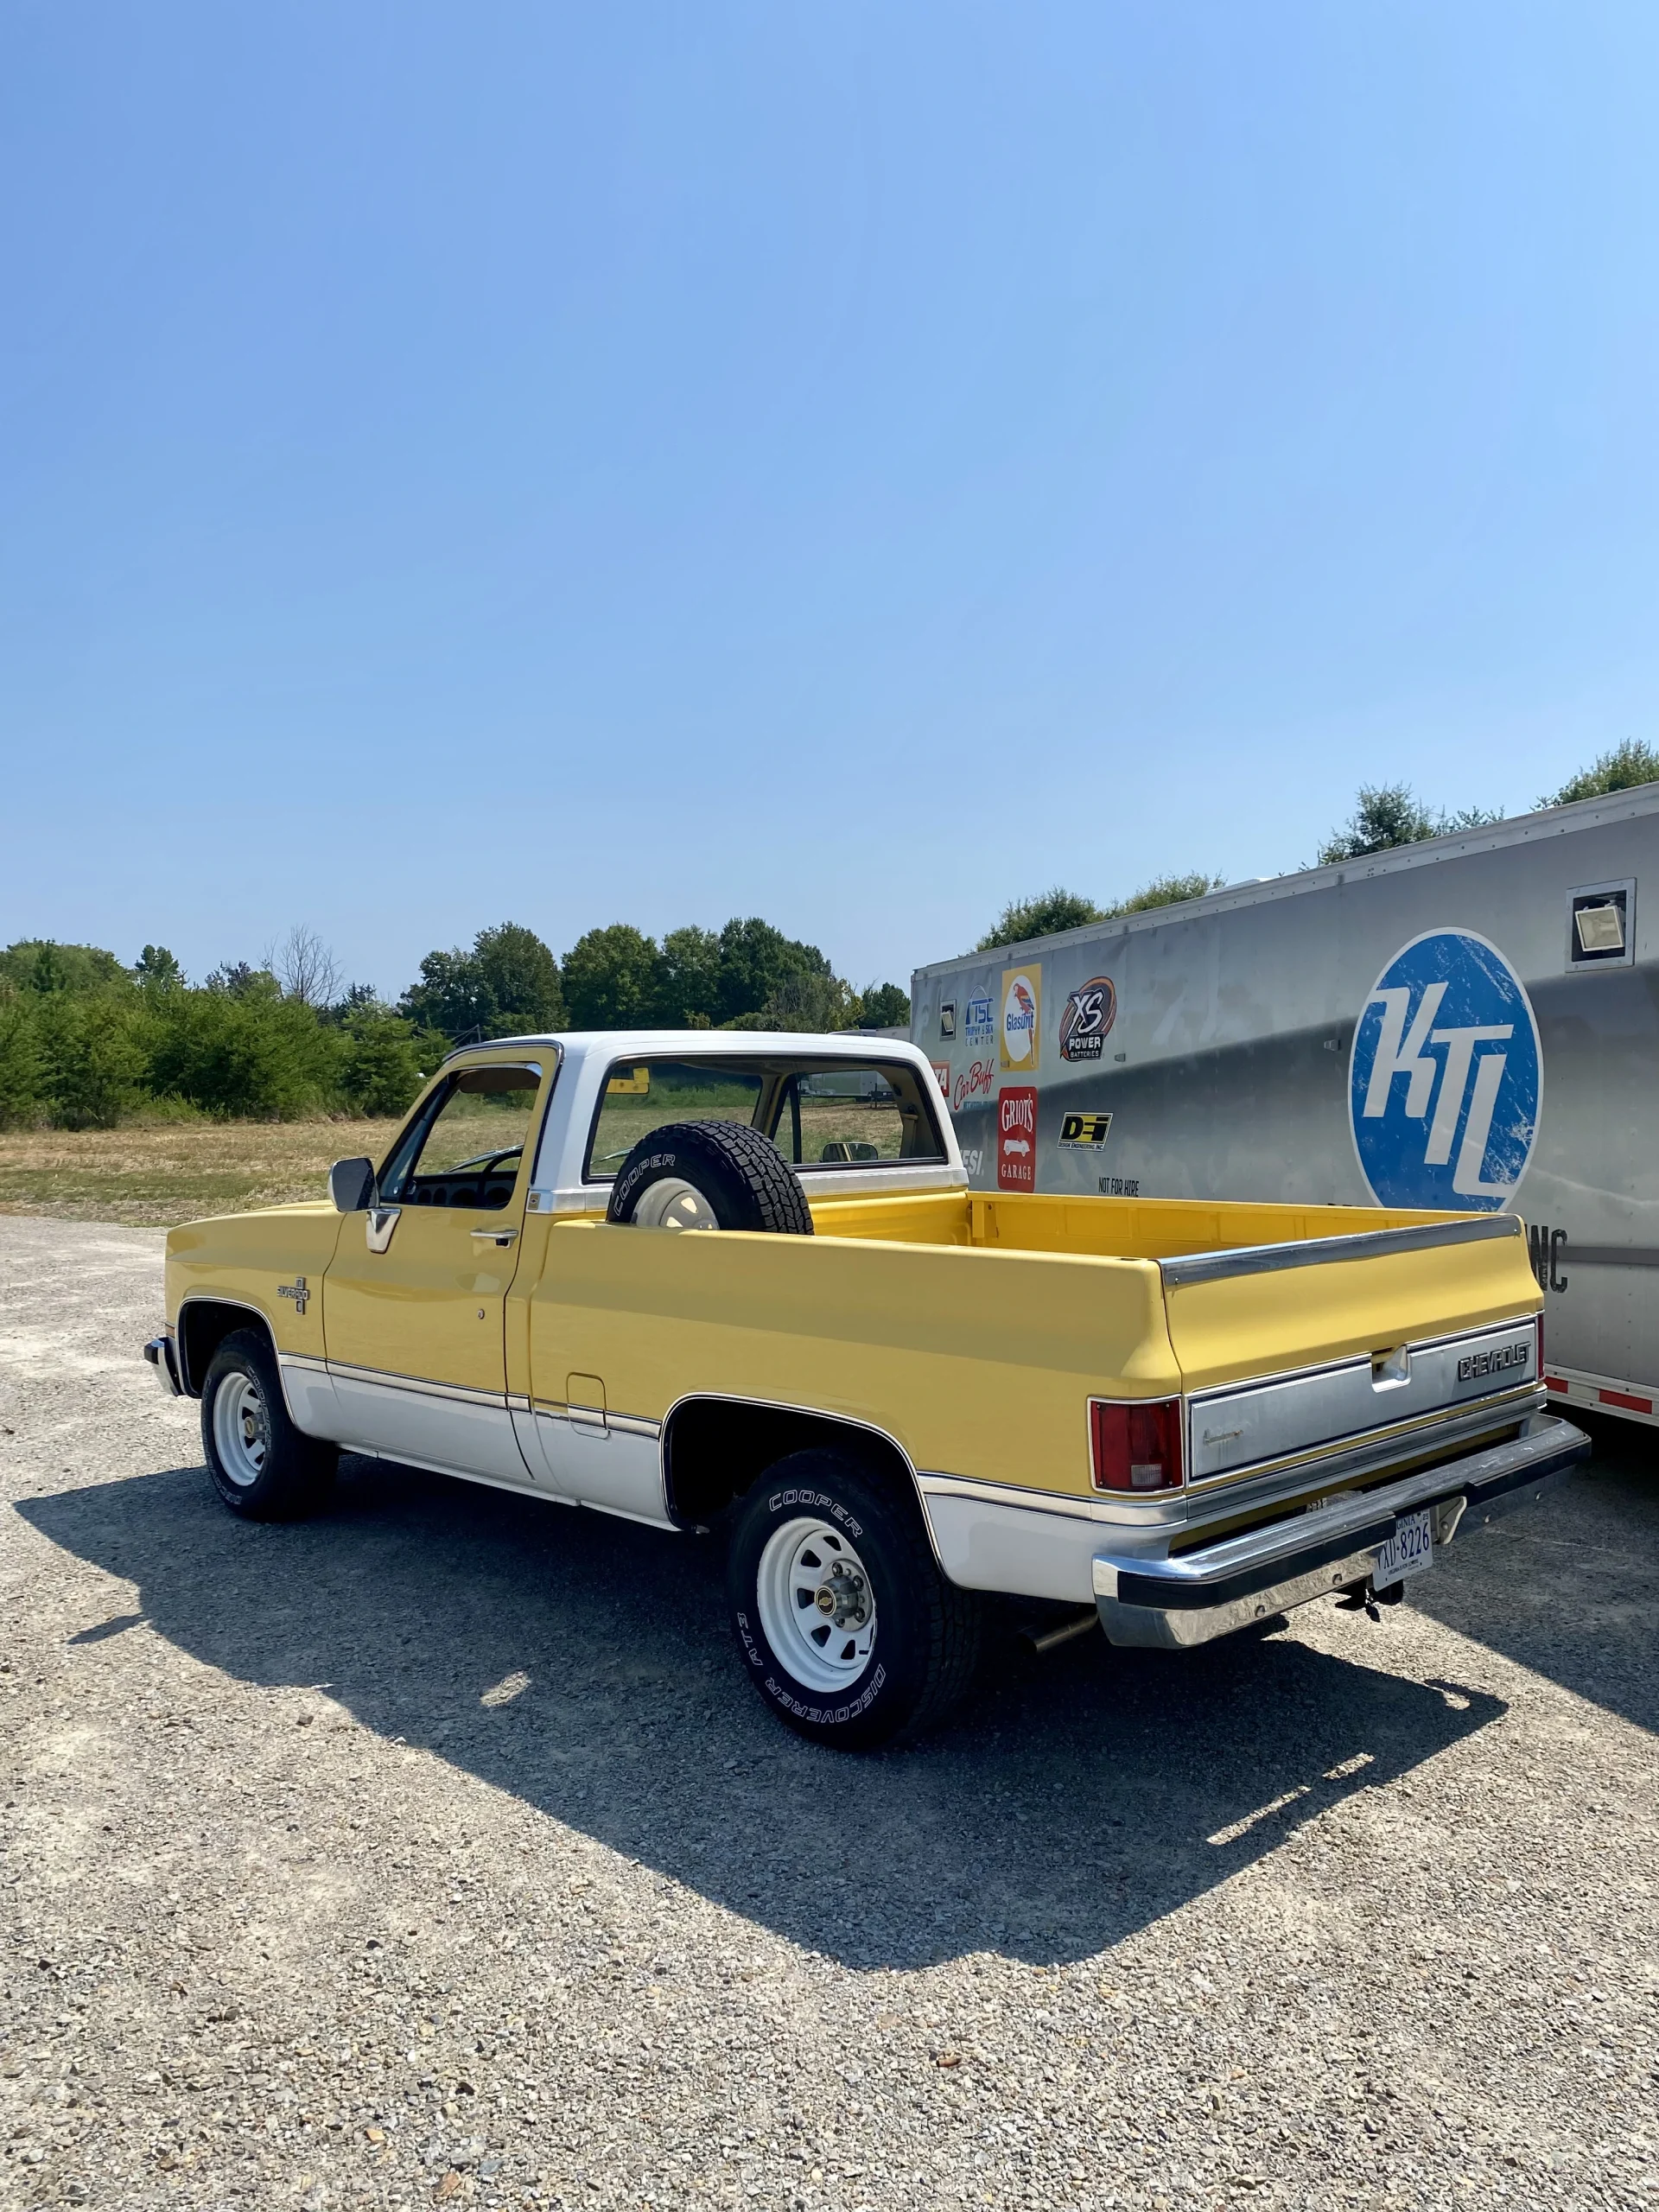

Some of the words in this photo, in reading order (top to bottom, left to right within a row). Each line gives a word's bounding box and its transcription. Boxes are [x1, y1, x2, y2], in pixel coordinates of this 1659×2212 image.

[1007, 1011, 1034, 1032] Glasurit
[1063, 992, 1103, 1046] XS
[965, 1035, 994, 1046] CENTER
[1069, 1037, 1101, 1051] POWER
[954, 1074, 969, 1110] Car
[969, 1058, 994, 1094] Buff
[1001, 1093, 1033, 1133] GRIOT'S
[613, 1154, 676, 1217] COOPER
[1001, 1164, 1031, 1180] GARAGE
[1099, 1177, 1110, 1192] NOT
[1111, 1178, 1122, 1195] FOR
[1124, 1179, 1139, 1198] HIRE
[1525, 1224, 1568, 1294] NC
[1458, 1341, 1532, 1382] CHEVROLET
[769, 1489, 863, 1538] COOPER
[1396, 1515, 1415, 1529] GINIA
[765, 1663, 887, 1723] DISCOVERER
